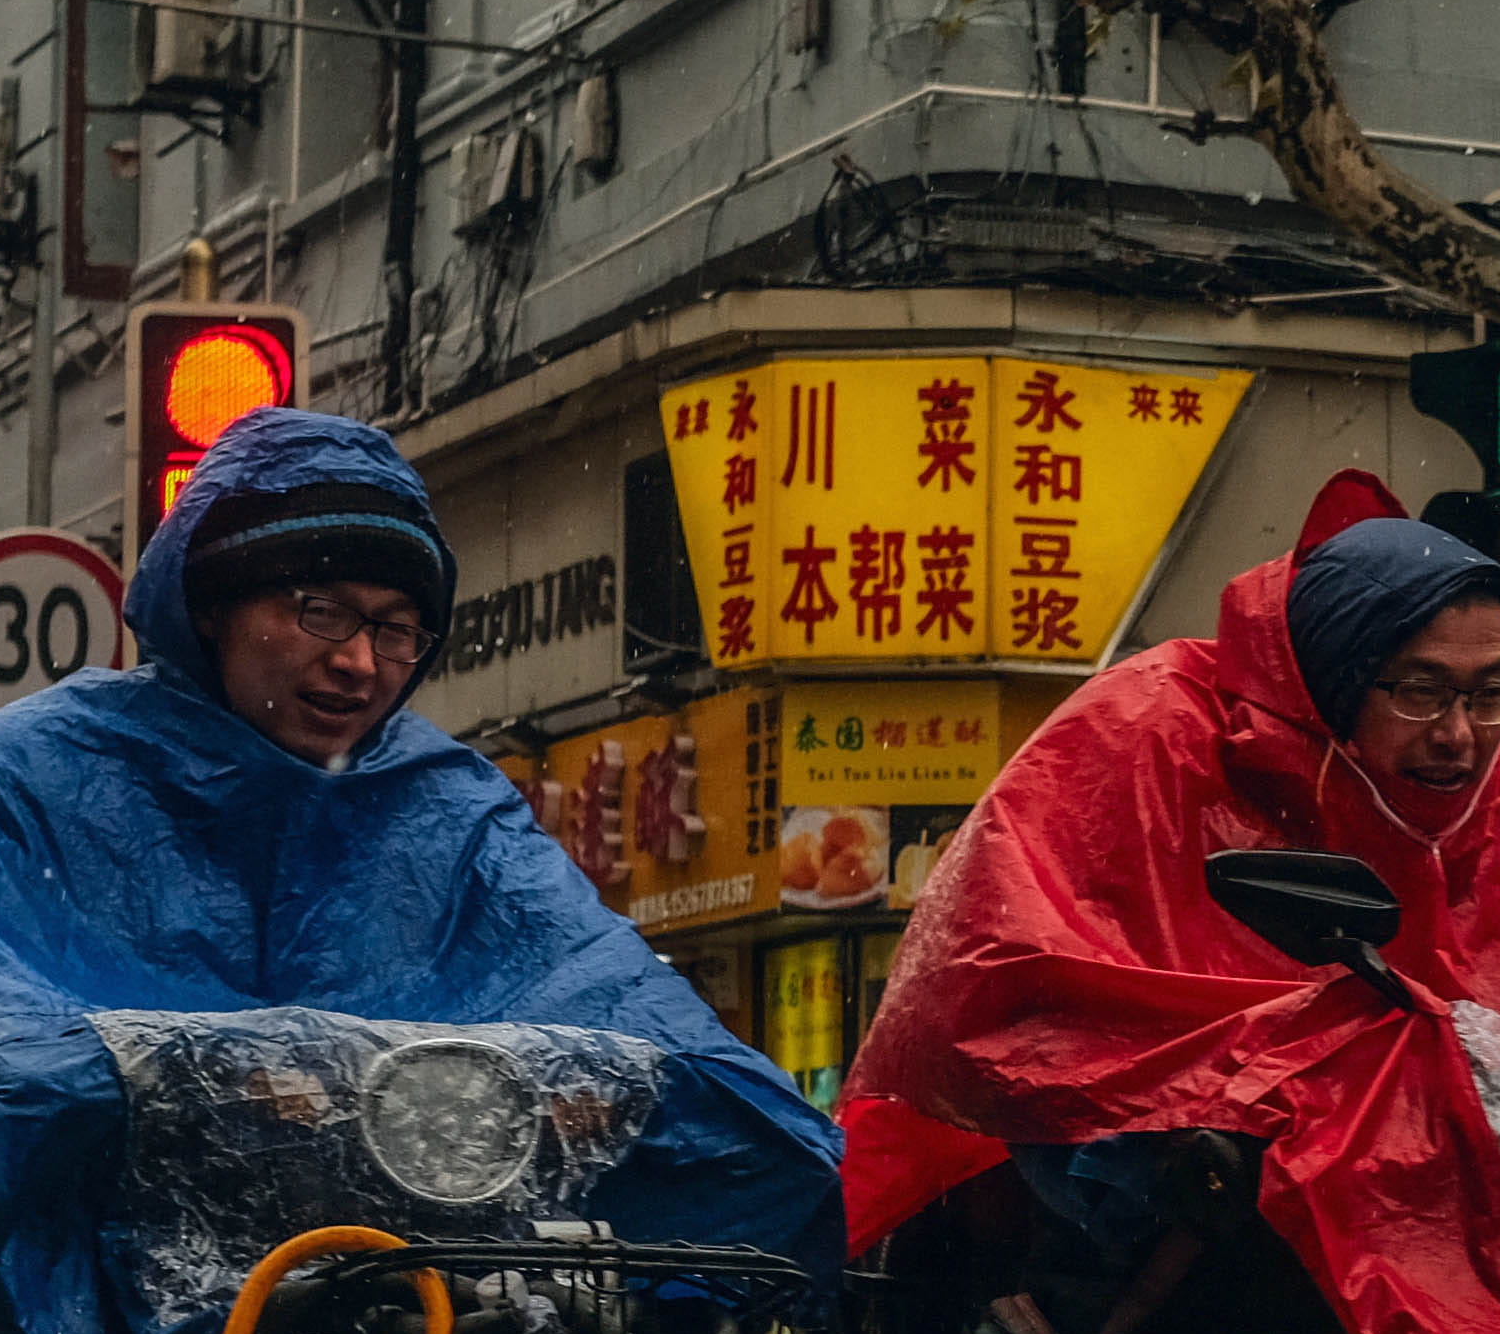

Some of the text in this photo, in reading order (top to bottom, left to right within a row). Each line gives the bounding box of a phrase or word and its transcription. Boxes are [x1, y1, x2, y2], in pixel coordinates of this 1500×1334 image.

[781, 378, 977, 492] 川菜
[1127, 384, 1205, 427] 来来
[717, 380, 758, 660] 永和豆浆
[1010, 370, 1083, 651] 永和豆浆
[780, 524, 977, 646] 本帮菜
